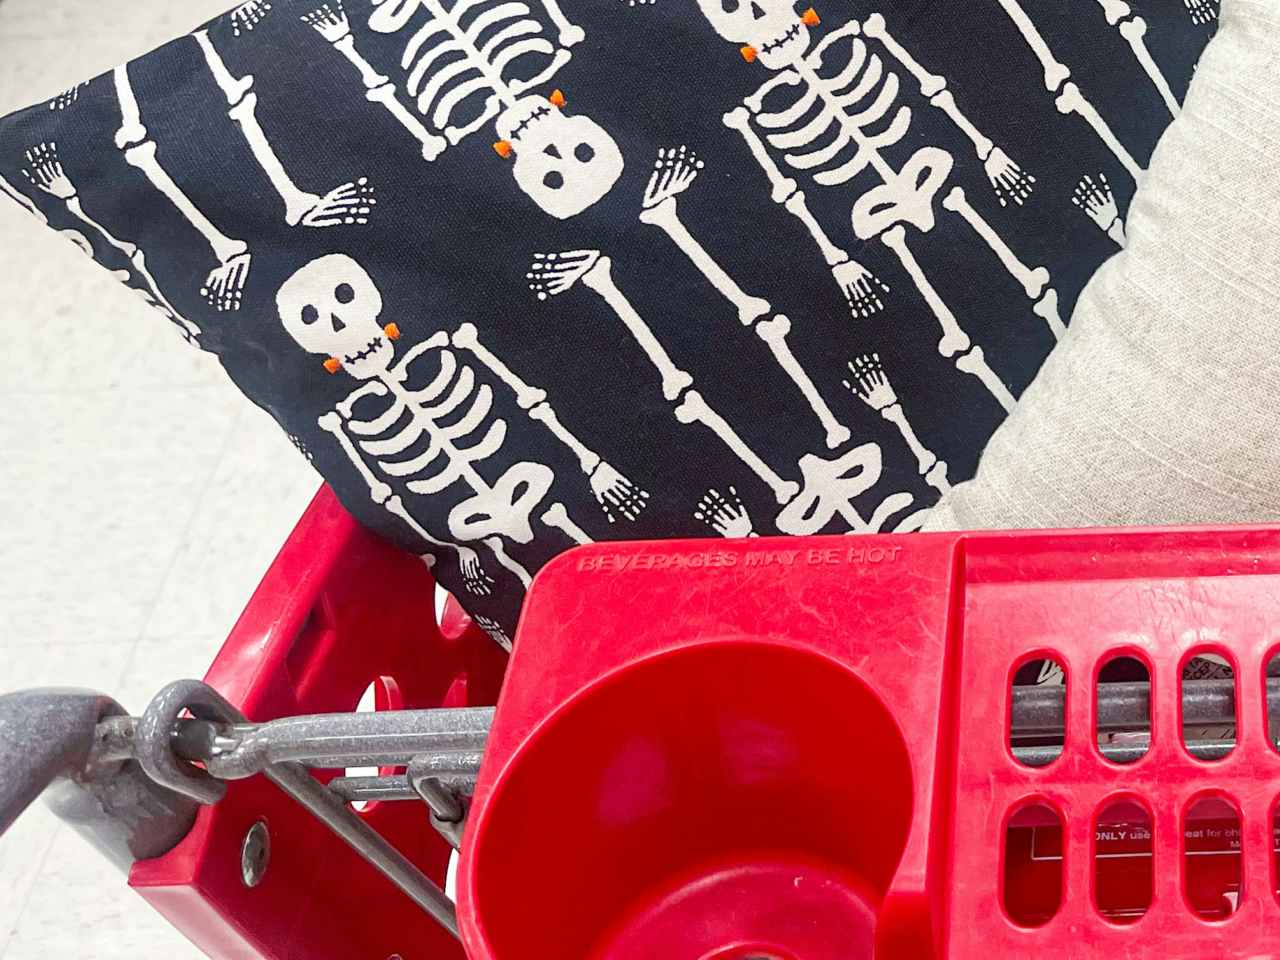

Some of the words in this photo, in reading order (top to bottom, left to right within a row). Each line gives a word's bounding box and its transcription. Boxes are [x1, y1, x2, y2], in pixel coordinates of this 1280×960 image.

[577, 550, 738, 572] BEVERAGES
[745, 549, 800, 568] MAY
[807, 547, 841, 565] BE
[848, 545, 902, 564] HOT
